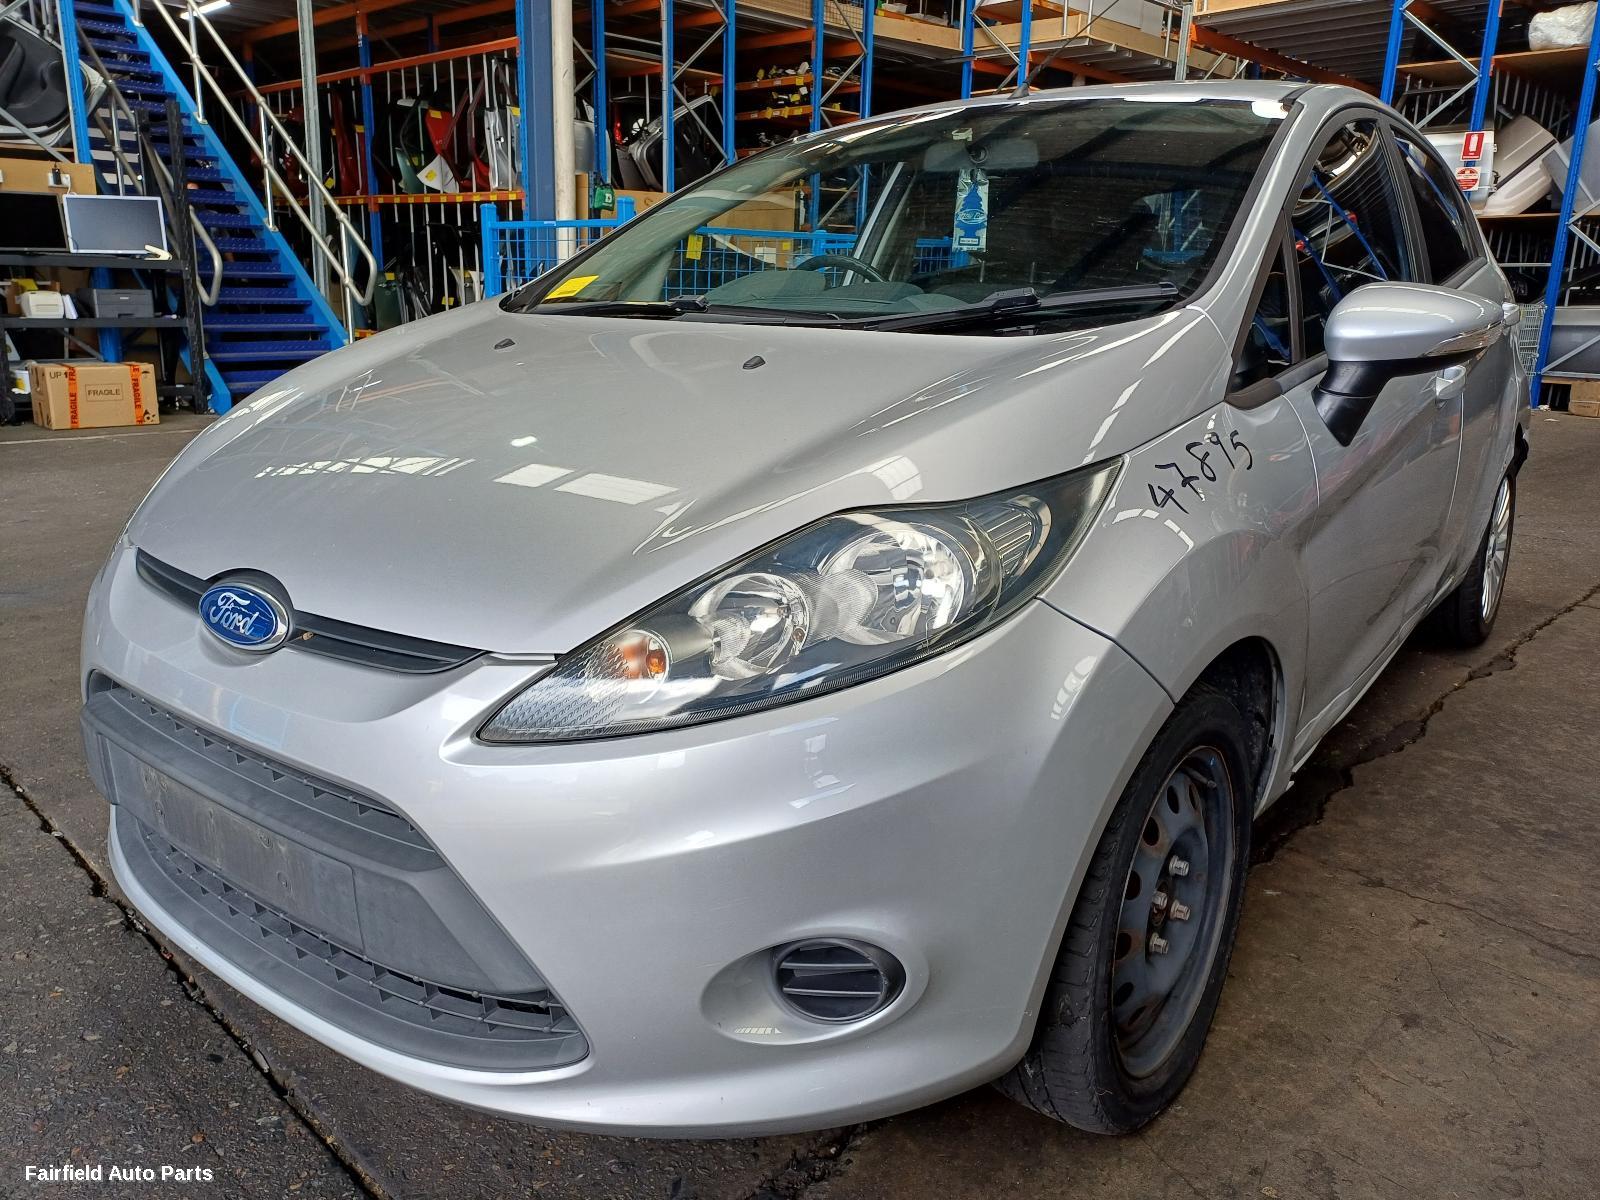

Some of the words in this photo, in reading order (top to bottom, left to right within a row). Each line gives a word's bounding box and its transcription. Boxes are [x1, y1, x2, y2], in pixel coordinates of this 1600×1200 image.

[49, 371, 62, 379] UP
[70, 392, 78, 424] FRAGILE
[88, 388, 121, 397] FRAGILE
[132, 378, 142, 409] FRAGILE
[1147, 429, 1253, 514] 47895
[209, 592, 260, 636] Ford
